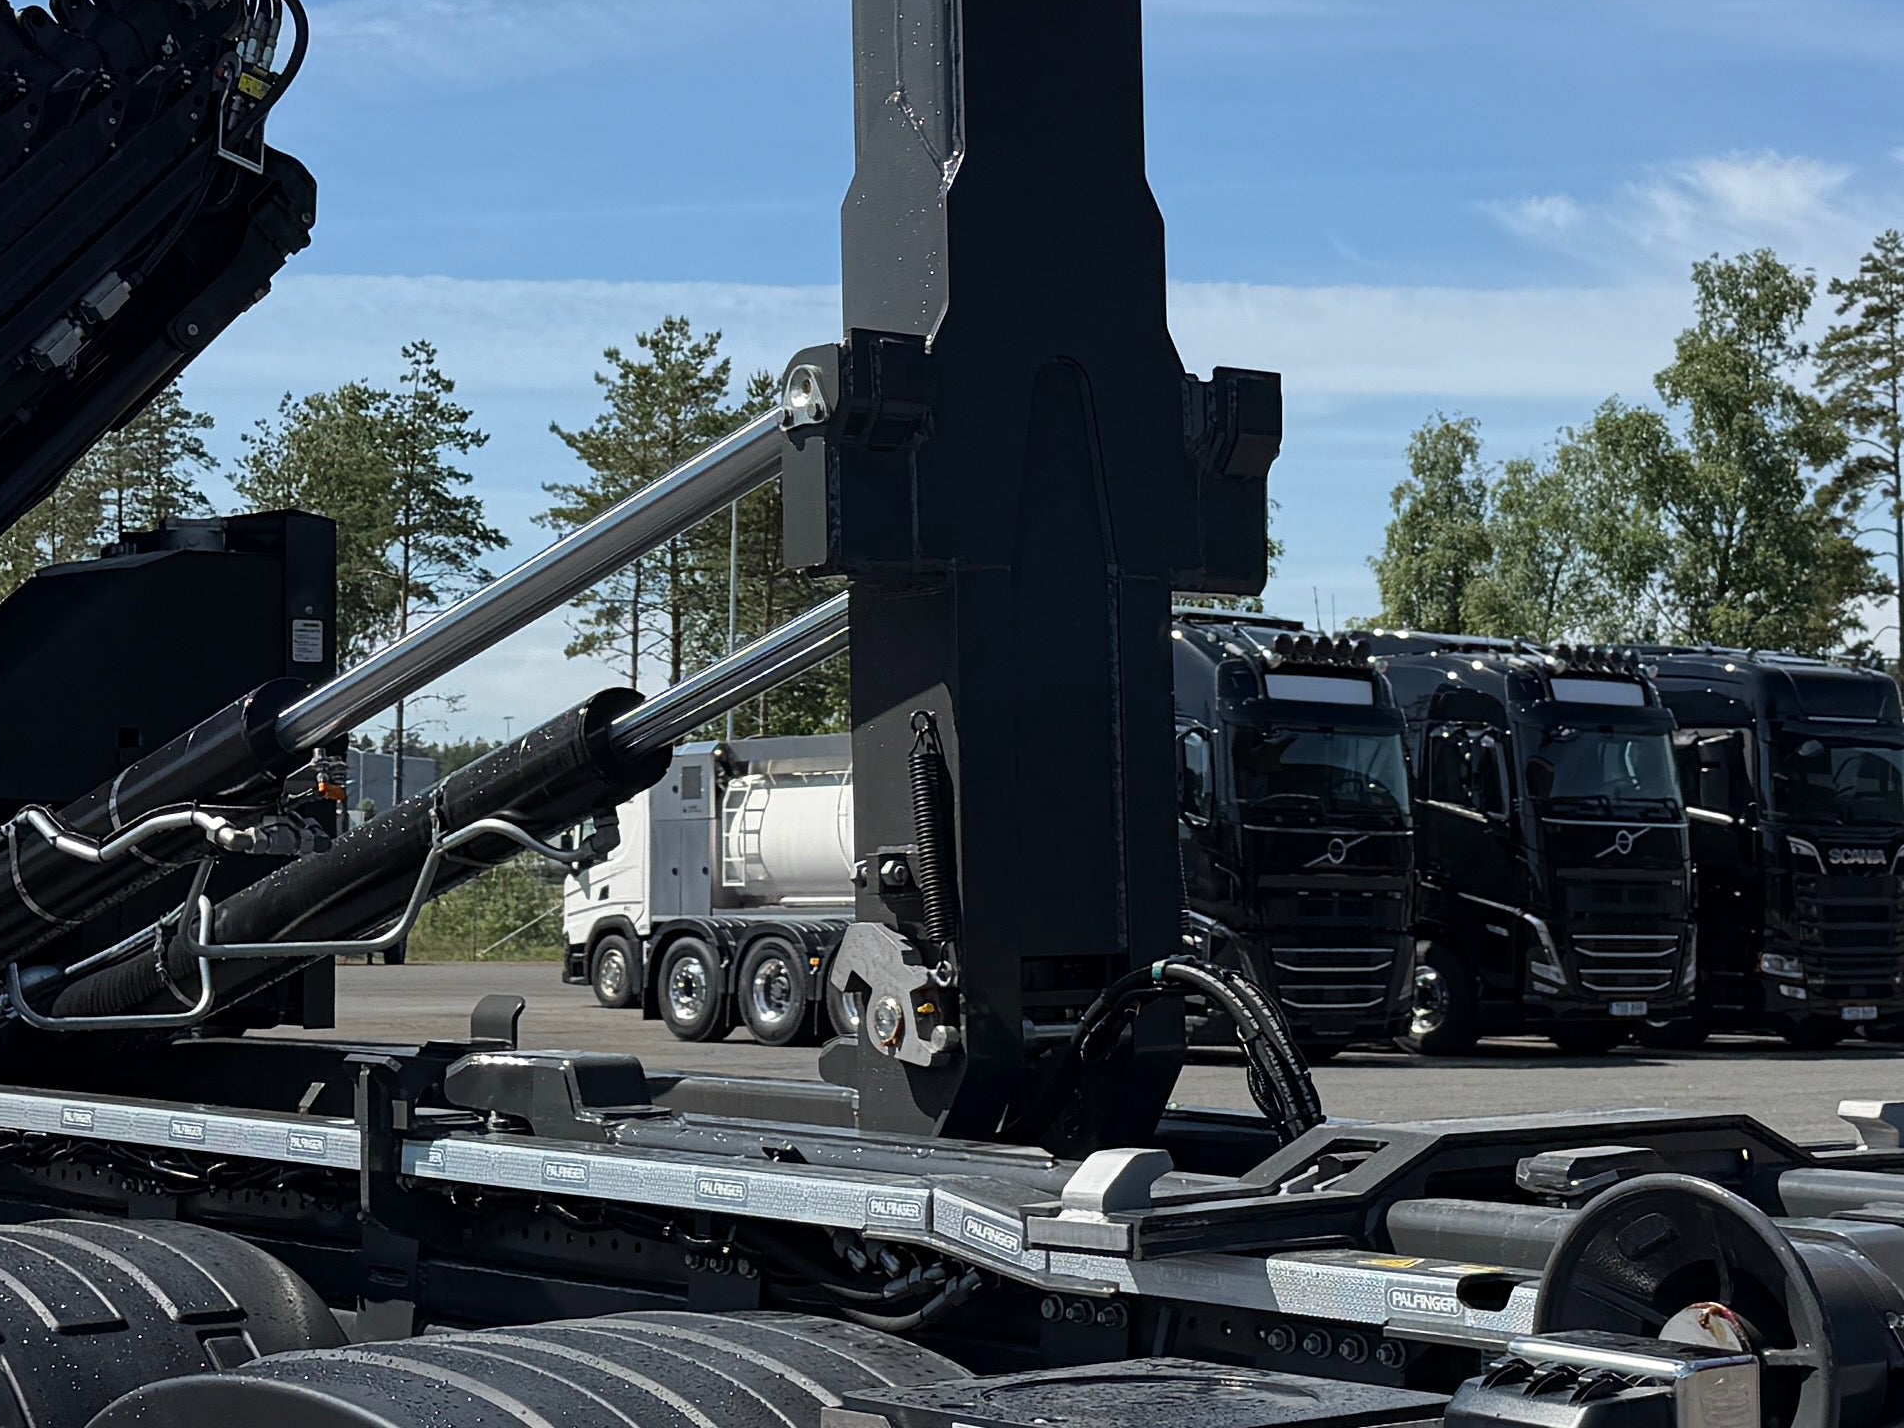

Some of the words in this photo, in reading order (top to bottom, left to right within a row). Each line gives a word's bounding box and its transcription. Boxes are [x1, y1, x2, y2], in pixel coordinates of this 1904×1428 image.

[870, 1199, 921, 1220] PALFINGER
[966, 1220, 1018, 1251] PALFINGER
[1392, 1290, 1458, 1313] PALFINGER
